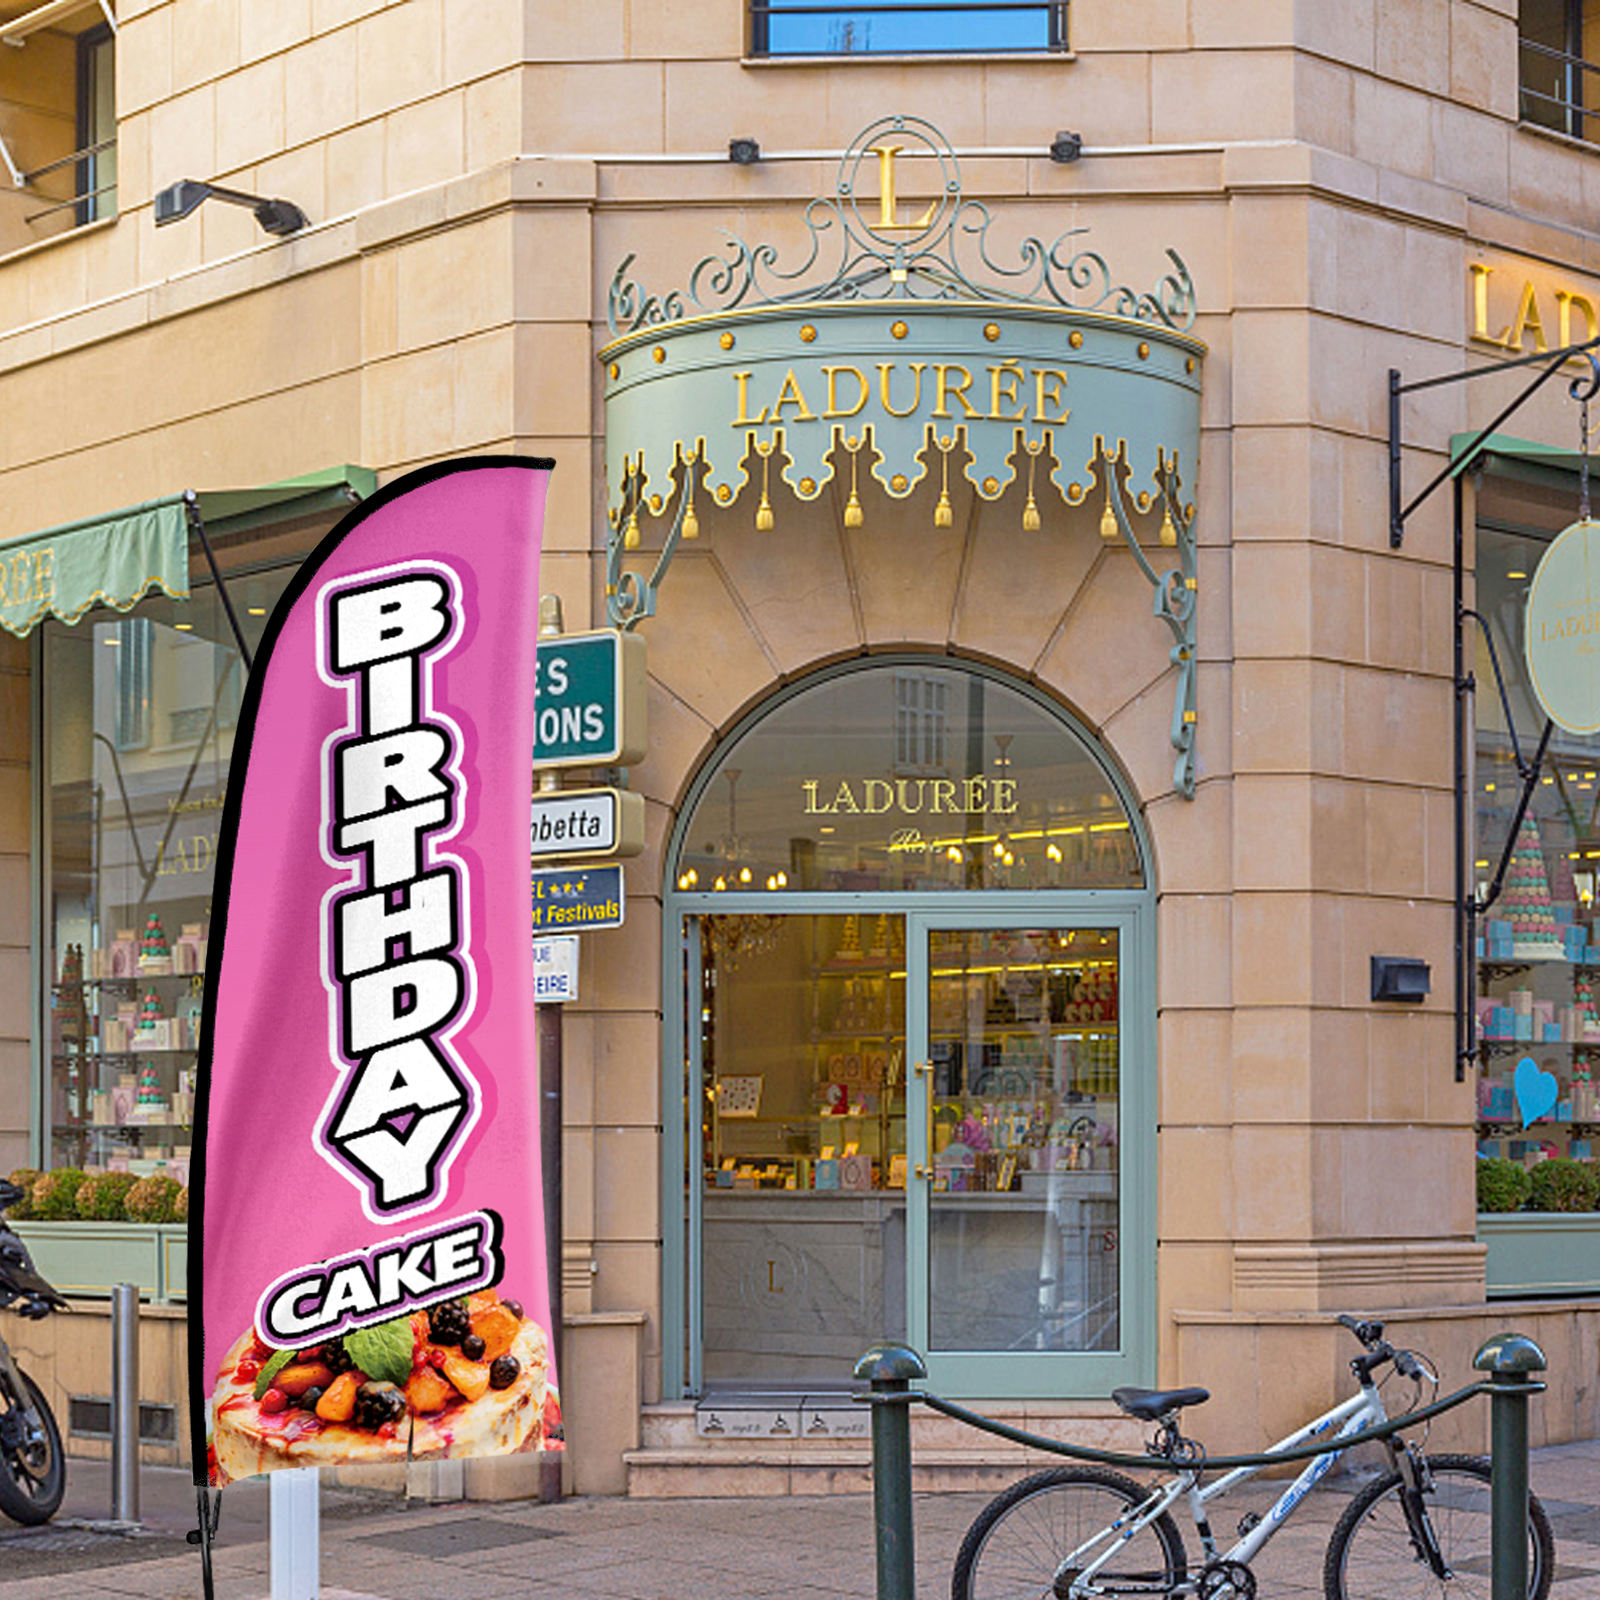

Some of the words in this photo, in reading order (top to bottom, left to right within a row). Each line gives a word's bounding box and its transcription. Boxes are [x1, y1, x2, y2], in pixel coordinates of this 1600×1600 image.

[869, 145, 938, 230] L
[731, 357, 1071, 428] LADURÉE
[803, 774, 1020, 815] LADURÉE
[331, 575, 467, 1210] BIRTHDAY
[547, 899, 620, 923] Festivals
[534, 974, 568, 995] EIRE
[267, 1224, 484, 1340] CAKE
[766, 1259, 785, 1294] L
